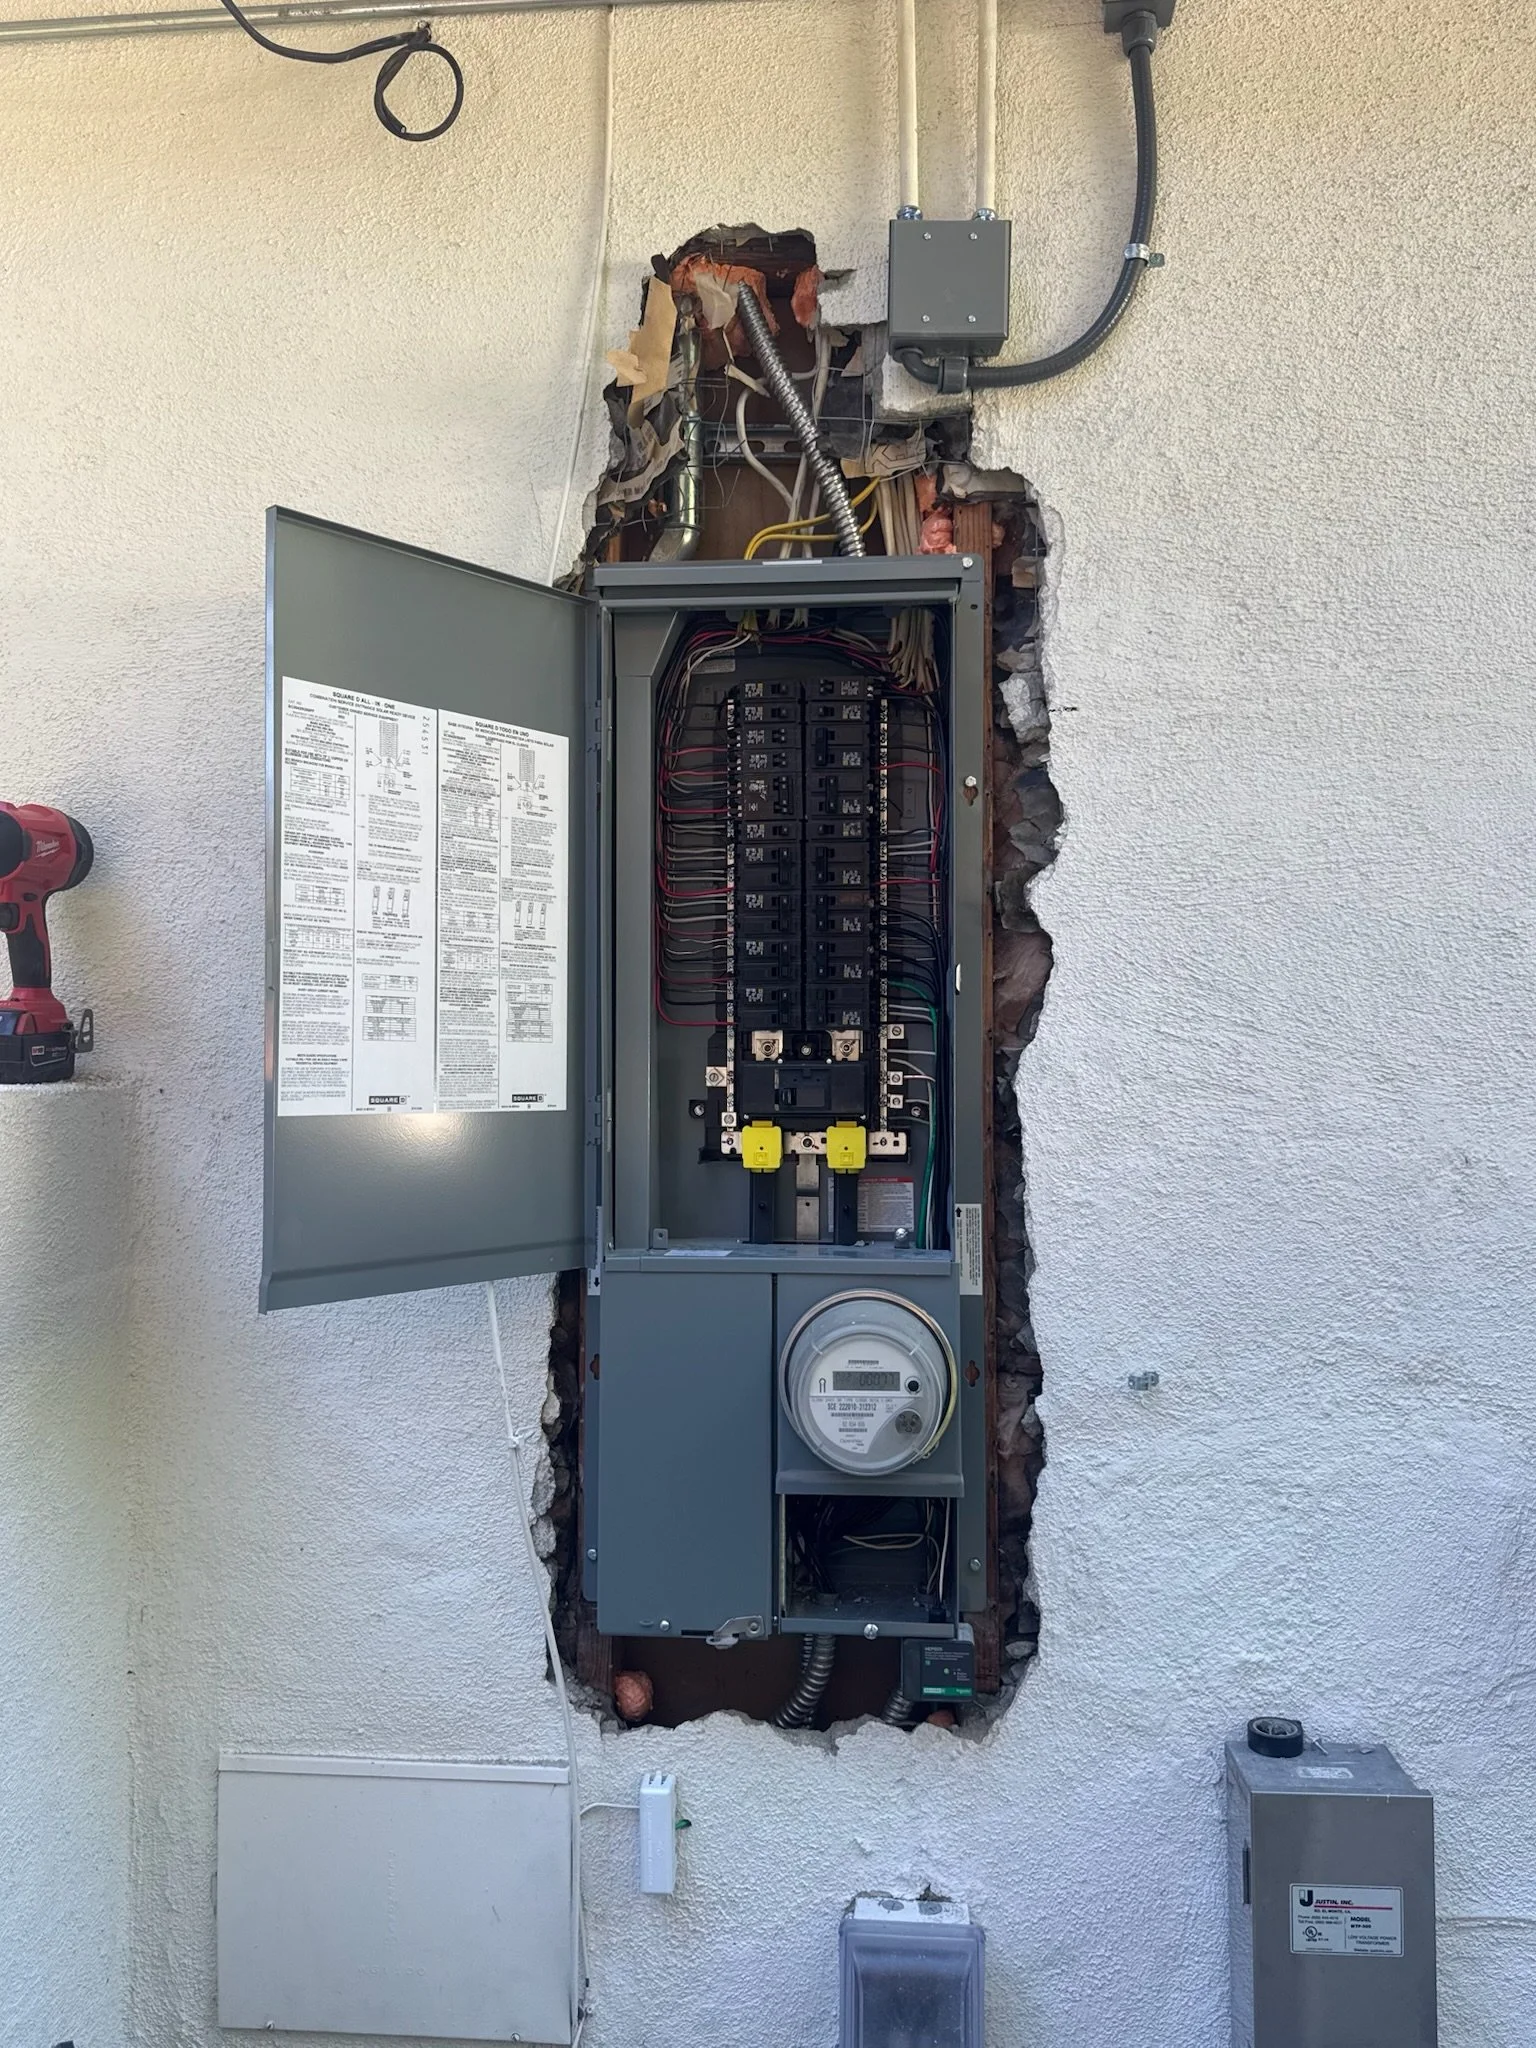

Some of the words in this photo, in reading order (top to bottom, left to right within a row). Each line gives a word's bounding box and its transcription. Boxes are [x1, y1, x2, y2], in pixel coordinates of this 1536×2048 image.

[332, 691, 354, 701] SQUARE
[475, 721, 494, 730] SQUARE
[828, 1403, 837, 1411] SCE
